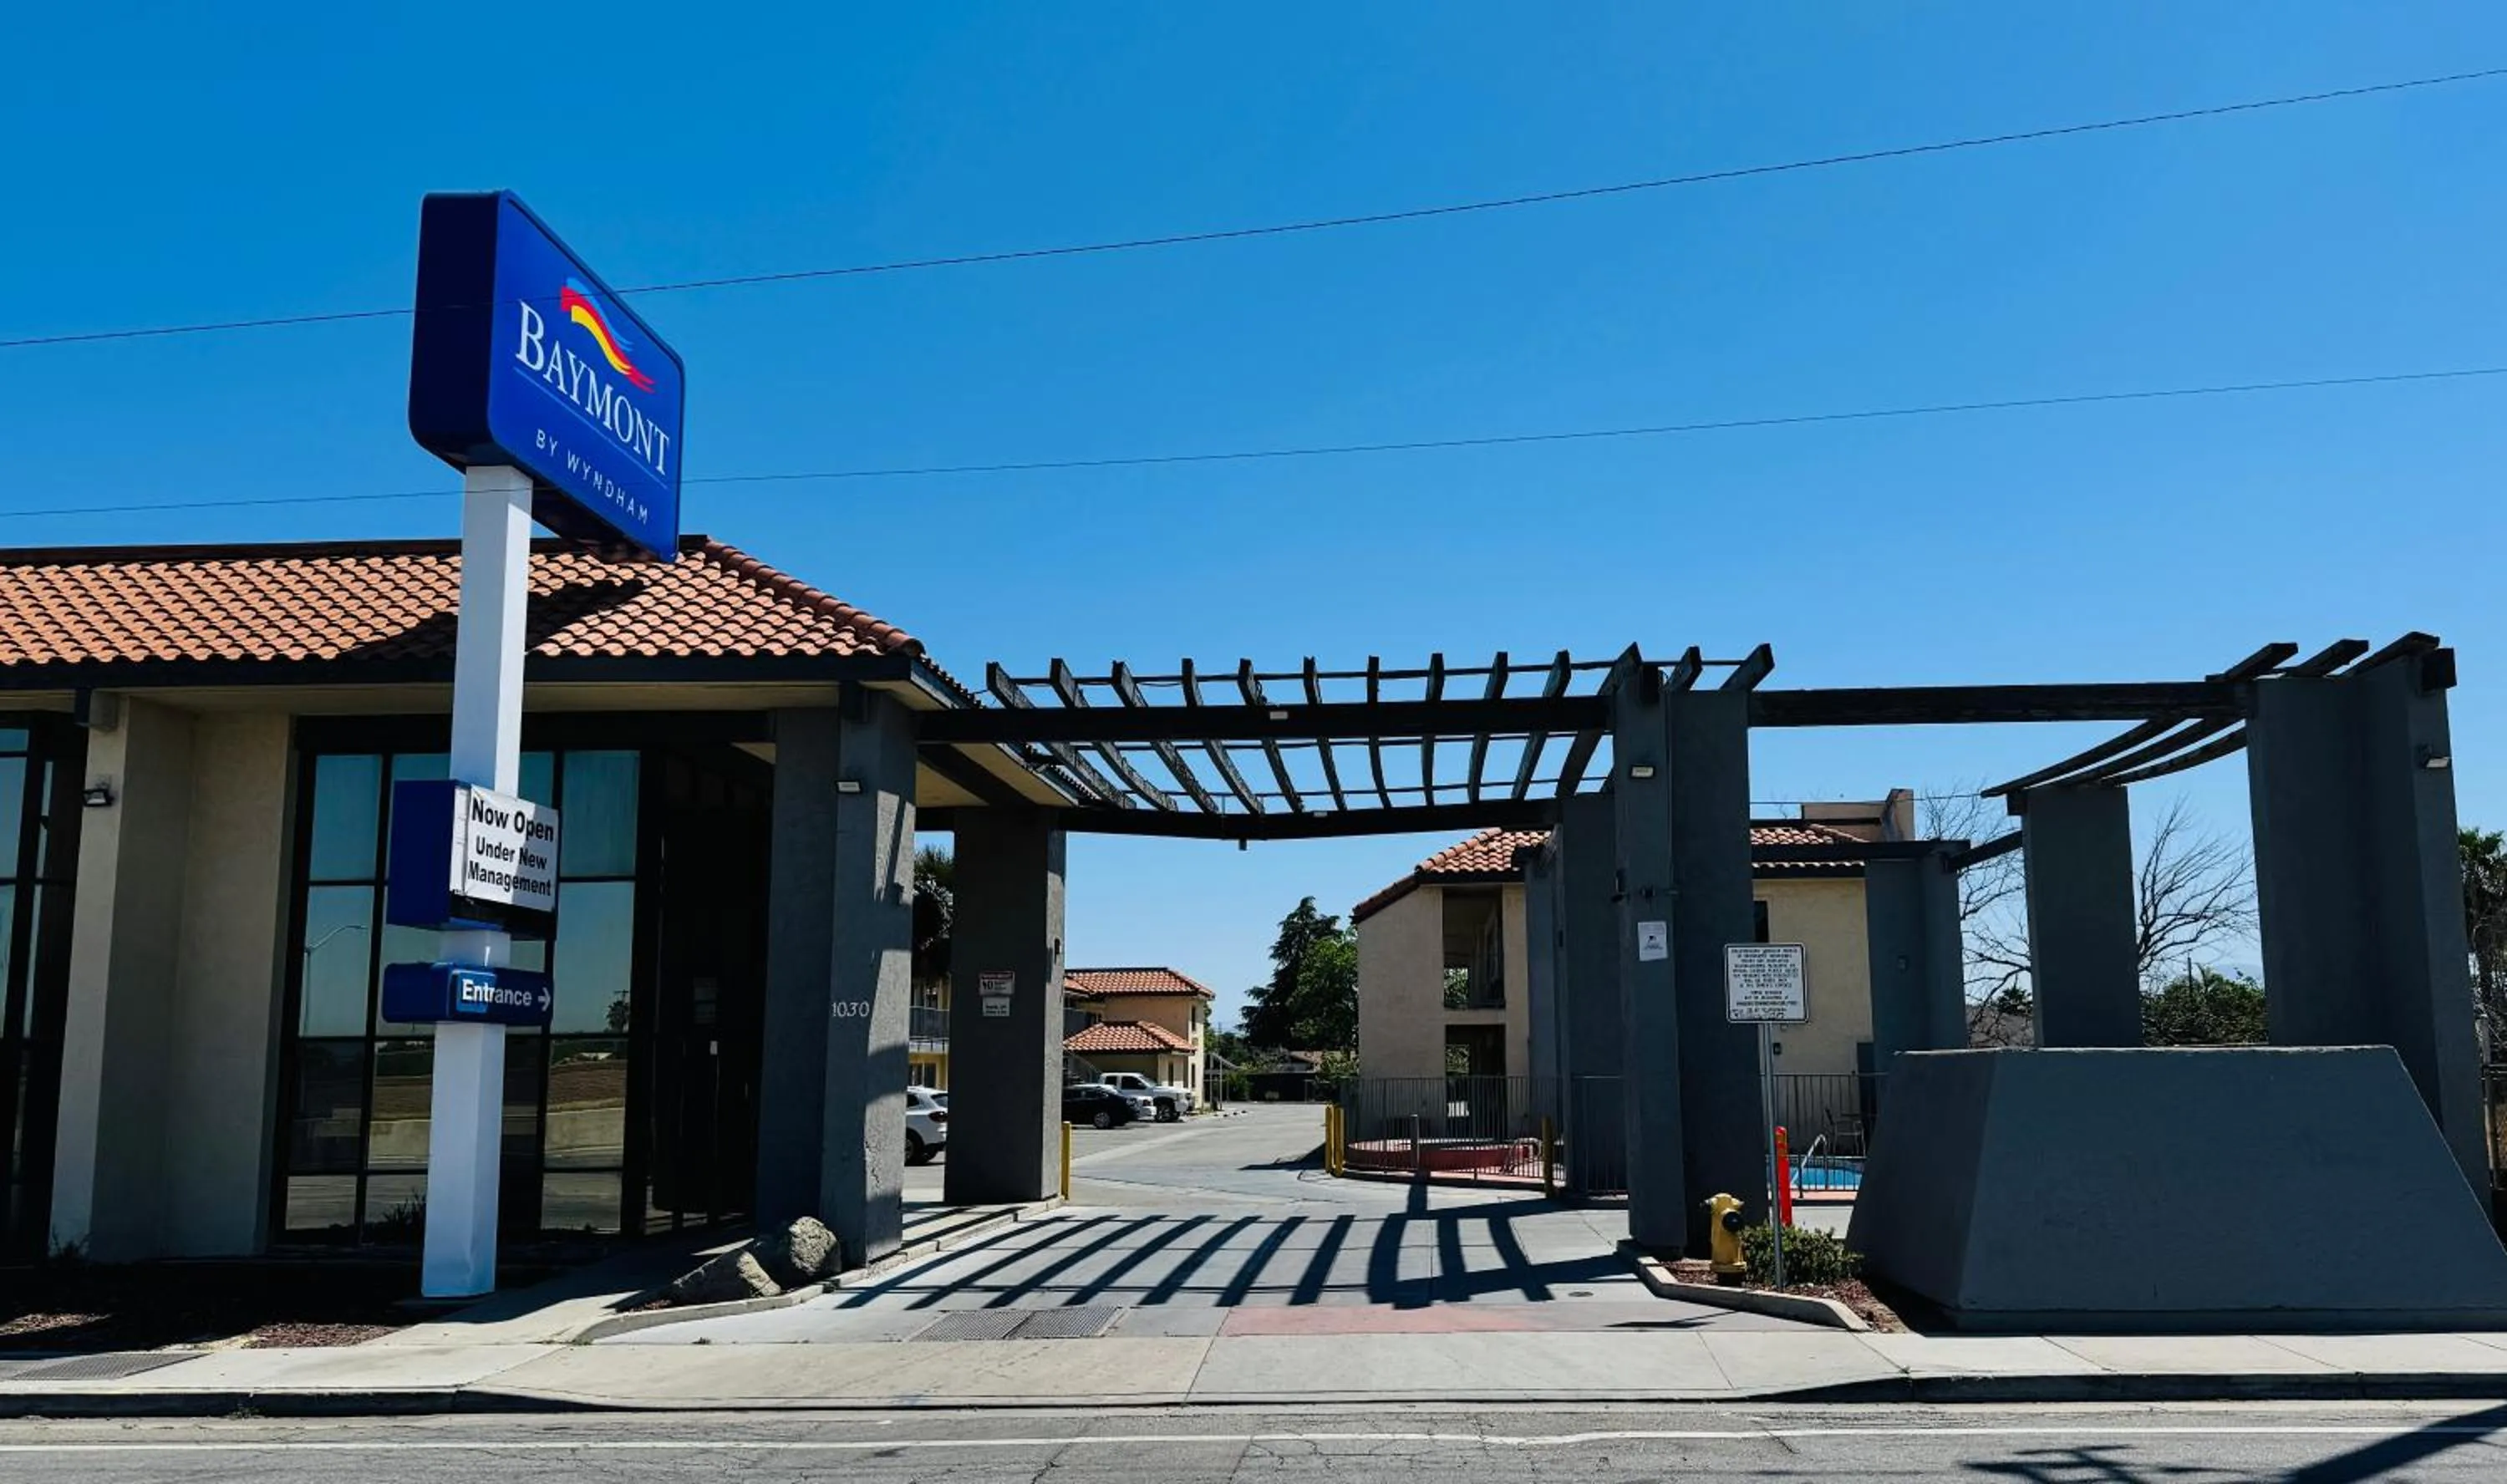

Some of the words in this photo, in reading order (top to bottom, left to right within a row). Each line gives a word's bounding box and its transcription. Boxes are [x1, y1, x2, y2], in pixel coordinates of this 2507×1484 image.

[515, 299, 669, 475] BAYMONT
[536, 429, 557, 457] BY
[567, 449, 648, 525] WYNDHAM
[471, 797, 511, 830] Now
[514, 811, 554, 842] Open
[475, 836, 515, 862] Under
[518, 846, 547, 871] New
[468, 861, 552, 897] Management
[462, 978, 532, 1007] Entrance
[831, 1001, 870, 1018] 1030
